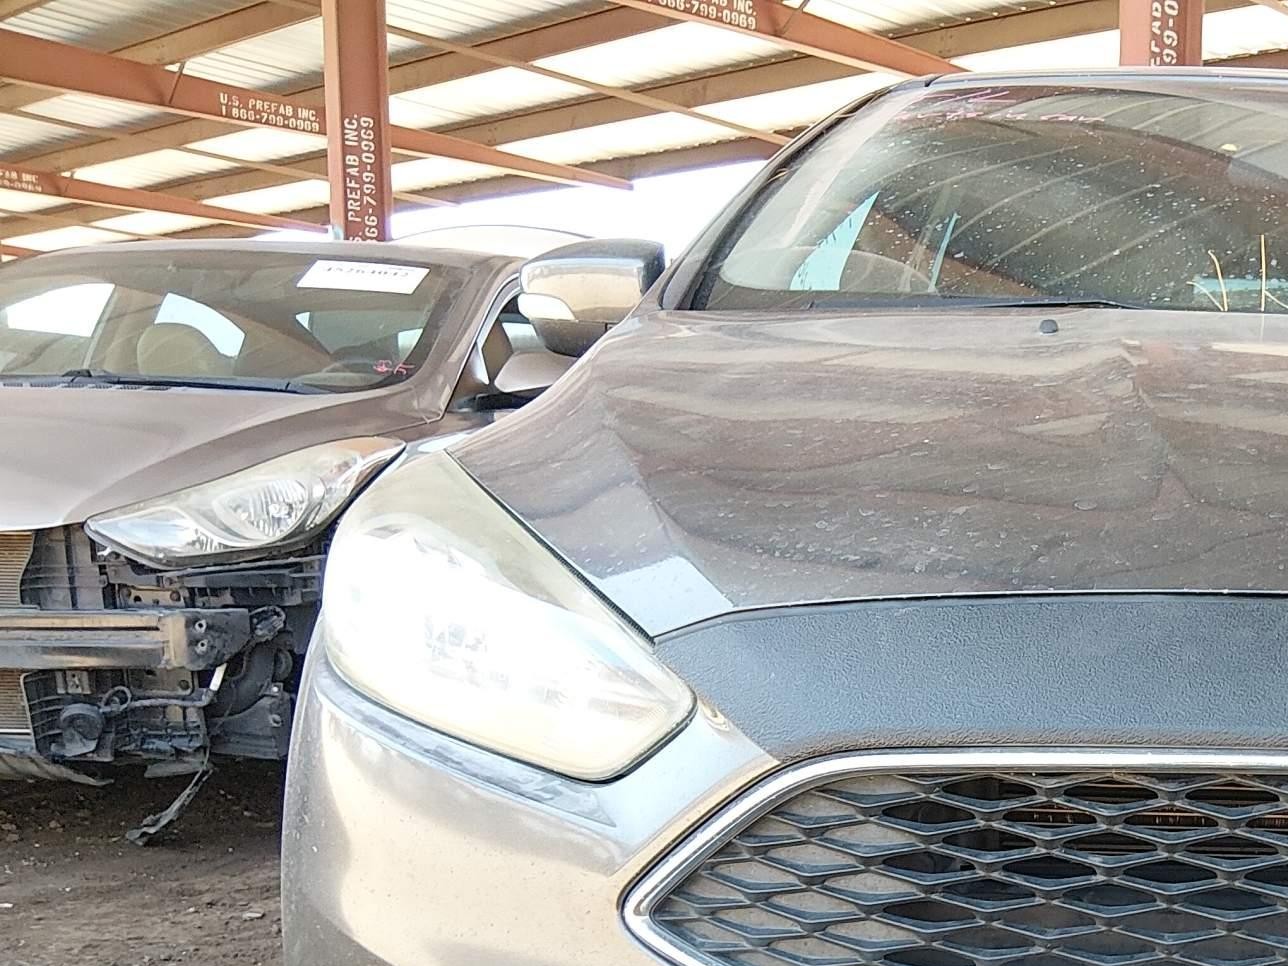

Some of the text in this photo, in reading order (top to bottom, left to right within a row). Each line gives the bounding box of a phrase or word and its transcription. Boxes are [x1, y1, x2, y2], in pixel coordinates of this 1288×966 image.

[219, 92, 320, 122] U.S. PREFAB INC.
[343, 113, 359, 146] INC.
[345, 154, 362, 222] PREFAB
